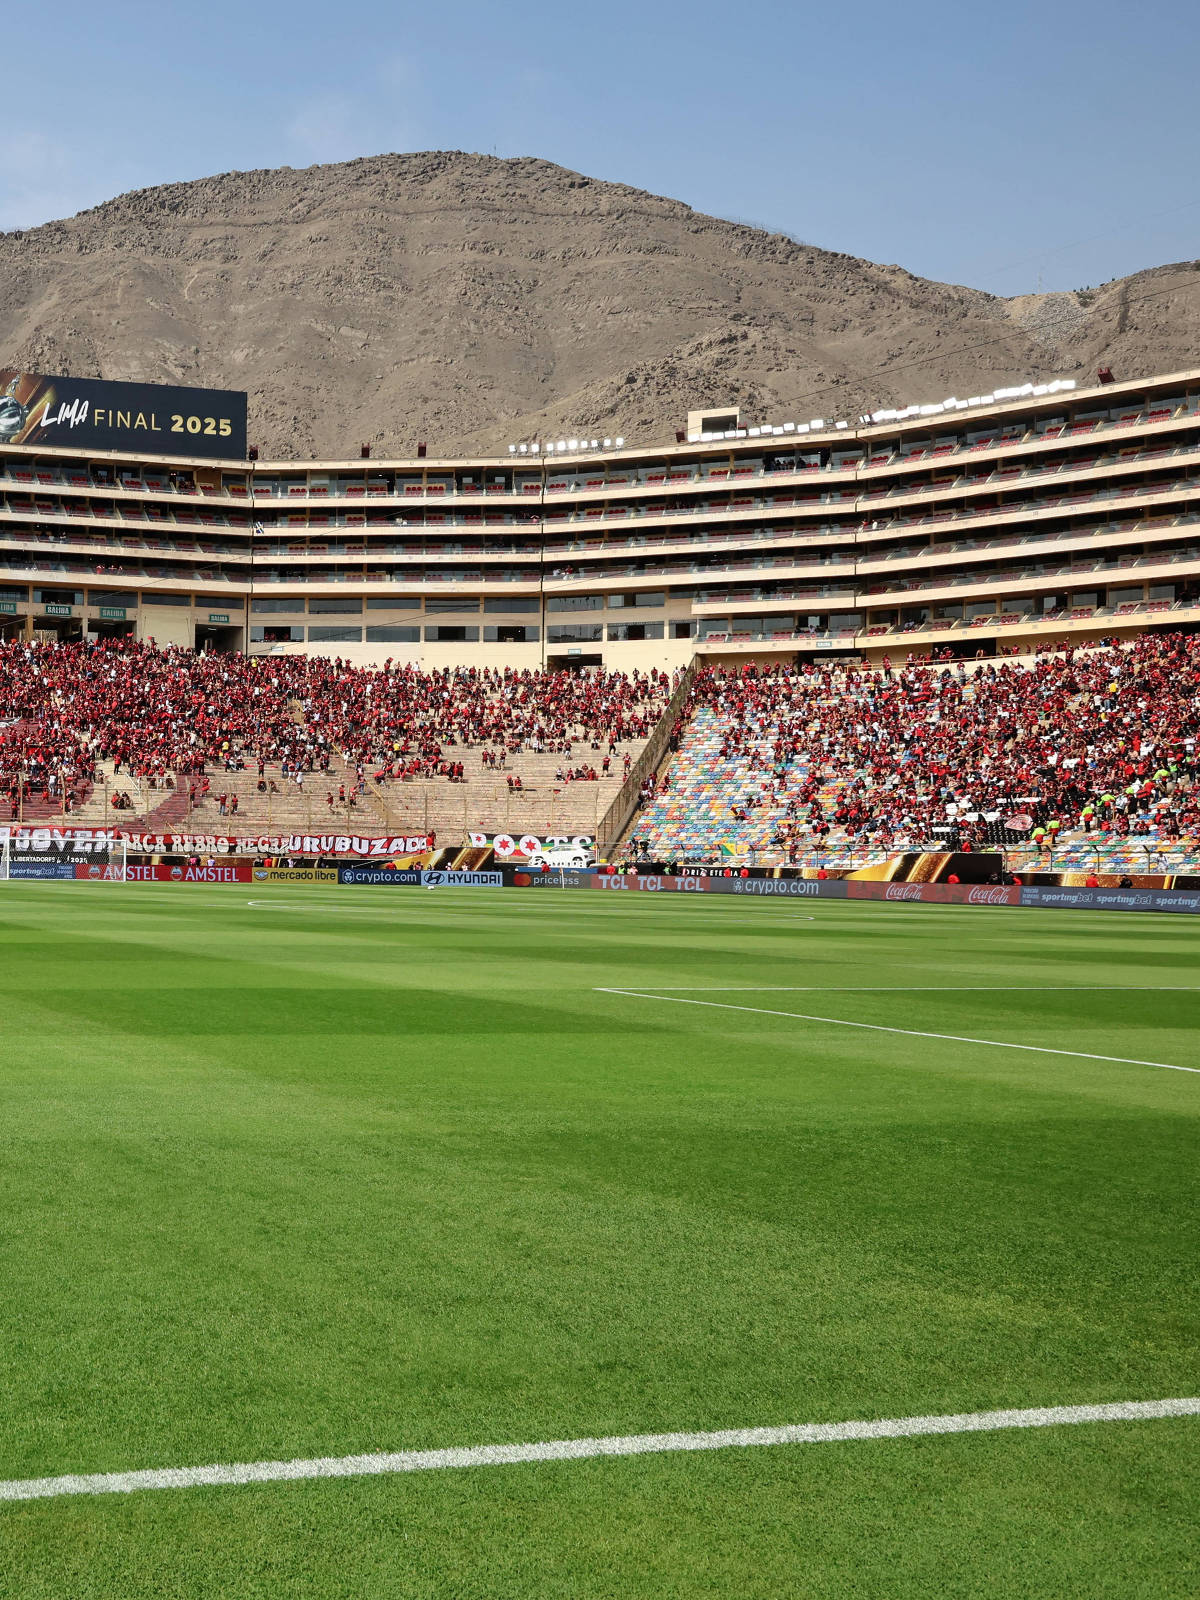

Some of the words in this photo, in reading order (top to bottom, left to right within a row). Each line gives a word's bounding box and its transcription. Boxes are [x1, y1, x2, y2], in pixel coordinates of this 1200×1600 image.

[40, 398, 90, 429] LIMA
[94, 409, 162, 431] FINAL
[170, 414, 232, 437] 2025
[47, 606, 70, 615] SALIDA
[102, 609, 124, 617] SALIDA
[289, 834, 428, 855] URUBUZADA
[103, 865, 159, 880] AMSTEL
[185, 867, 240, 882] AMSTEL
[270, 870, 314, 880] mercado
[315, 870, 336, 880] libre
[355, 871, 418, 884] crypto.com
[448, 874, 501, 884] HYUNDAI
[599, 875, 629, 890] TCL
[637, 876, 665, 891] TCL
[675, 877, 705, 892] TCL
[745, 879, 819, 895] crypto.com
